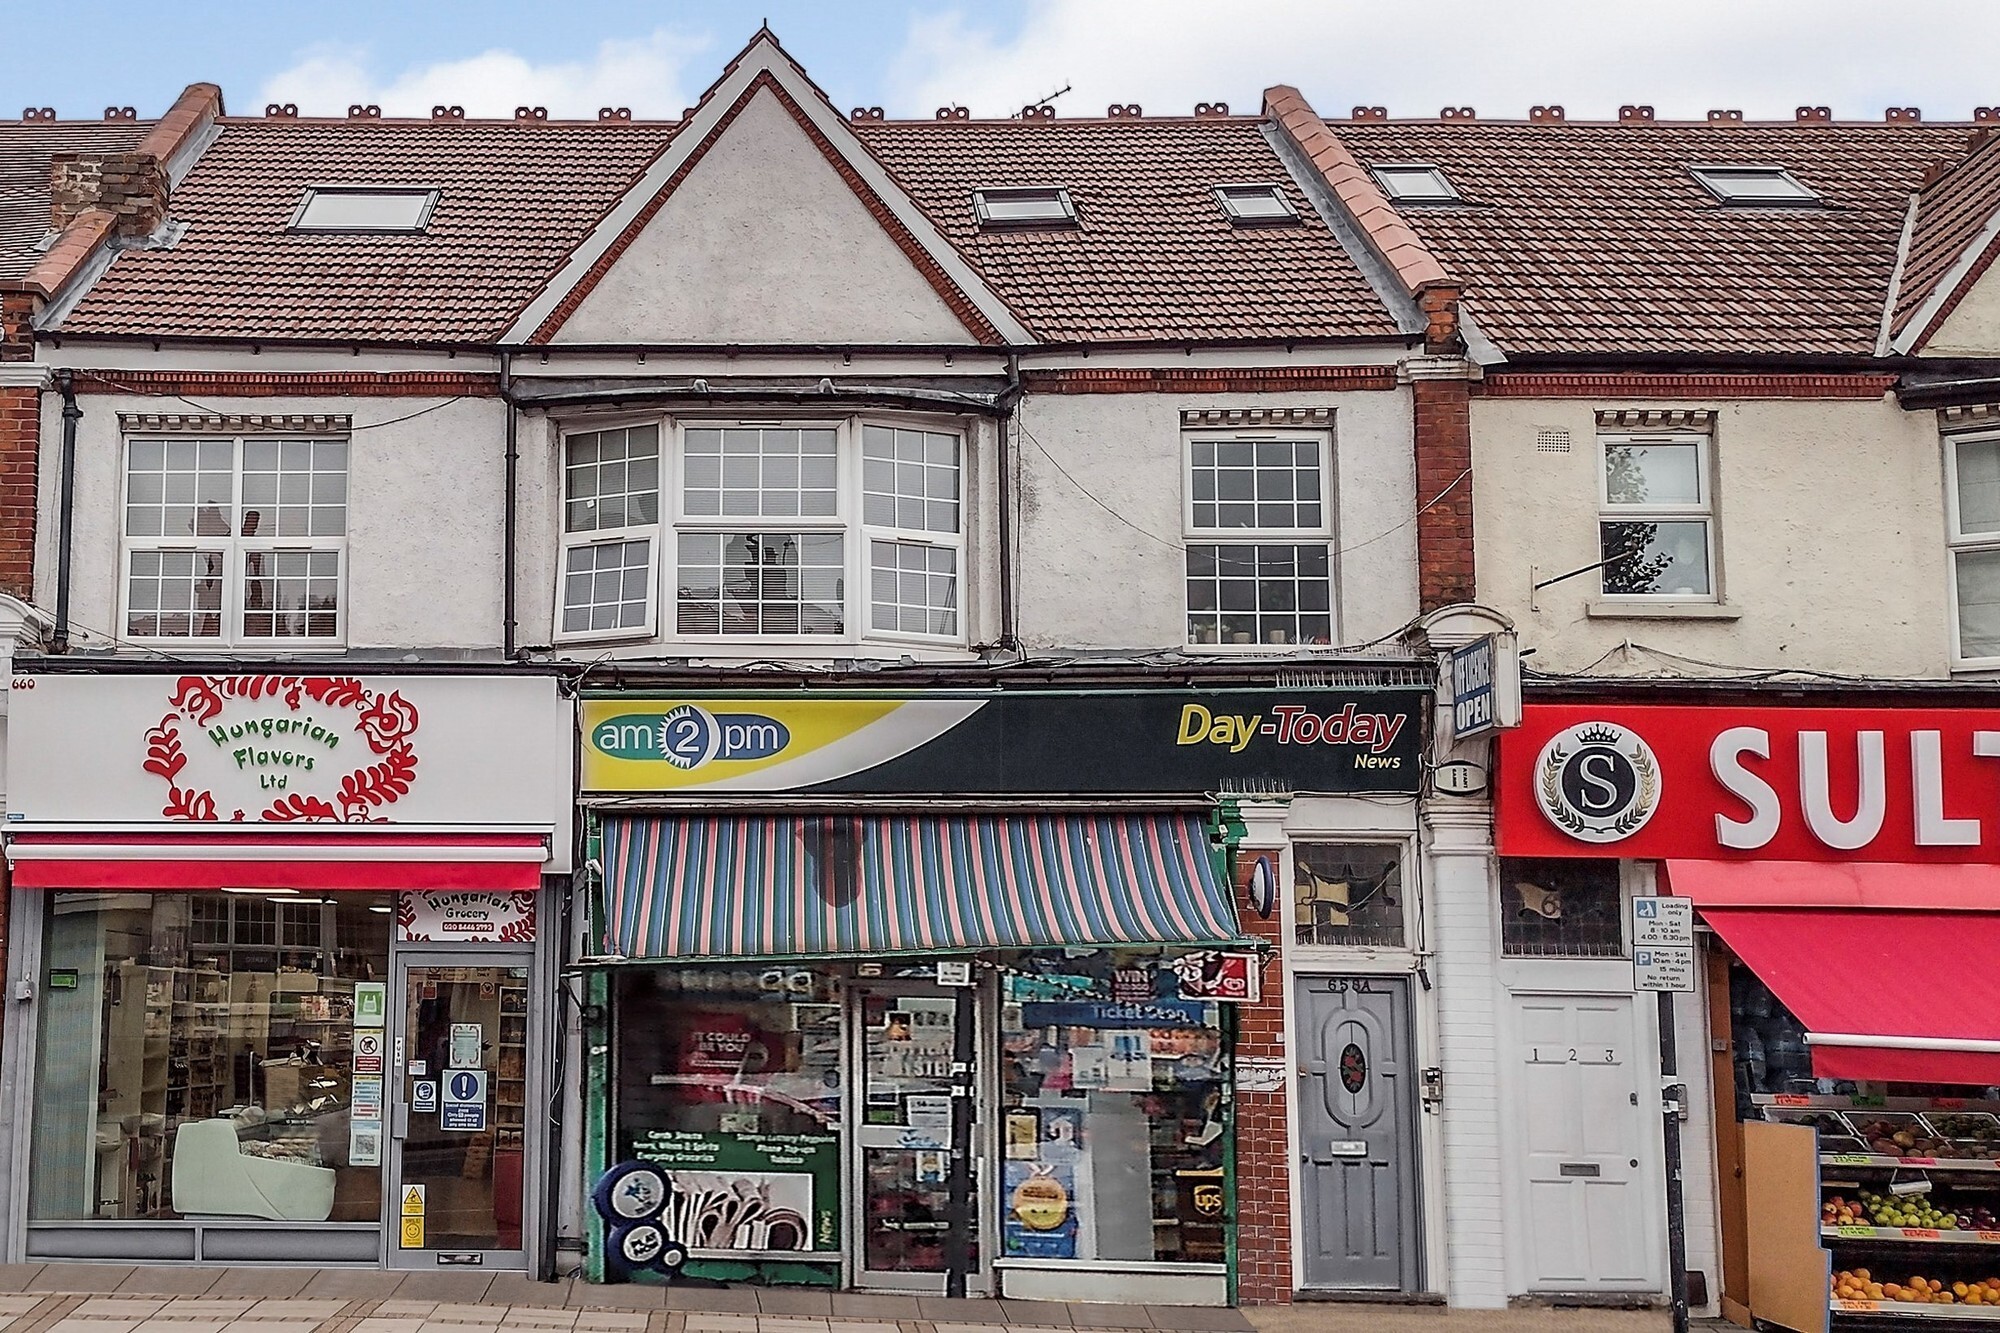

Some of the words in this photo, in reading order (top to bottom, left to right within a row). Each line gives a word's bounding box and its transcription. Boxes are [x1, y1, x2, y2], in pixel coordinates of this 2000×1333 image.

[12, 678, 35, 689] 660
[1456, 692, 1491, 731] OPEN
[208, 716, 339, 748] Hungarian
[1176, 703, 1407, 754] Day-Today
[675, 720, 700, 753] 2
[232, 746, 315, 770] Flavors
[1354, 753, 1401, 769] News
[260, 774, 288, 789] Ltd
[1578, 754, 1618, 810] S
[428, 892, 510, 912] Hungarian
[1662, 902, 1688, 910] Loading
[446, 907, 490, 920] Grocery
[1114, 969, 1148, 983] WIN
[1090, 1003, 1144, 1019] Ticket
[692, 1032, 704, 1041] IT
[706, 1032, 751, 1042] COULD
[699, 1042, 715, 1052] BE
[717, 1042, 745, 1053] YOU
[1533, 1048, 1539, 1061] 1
[1568, 1048, 1577, 1061] 2
[1605, 1049, 1614, 1063] 3
